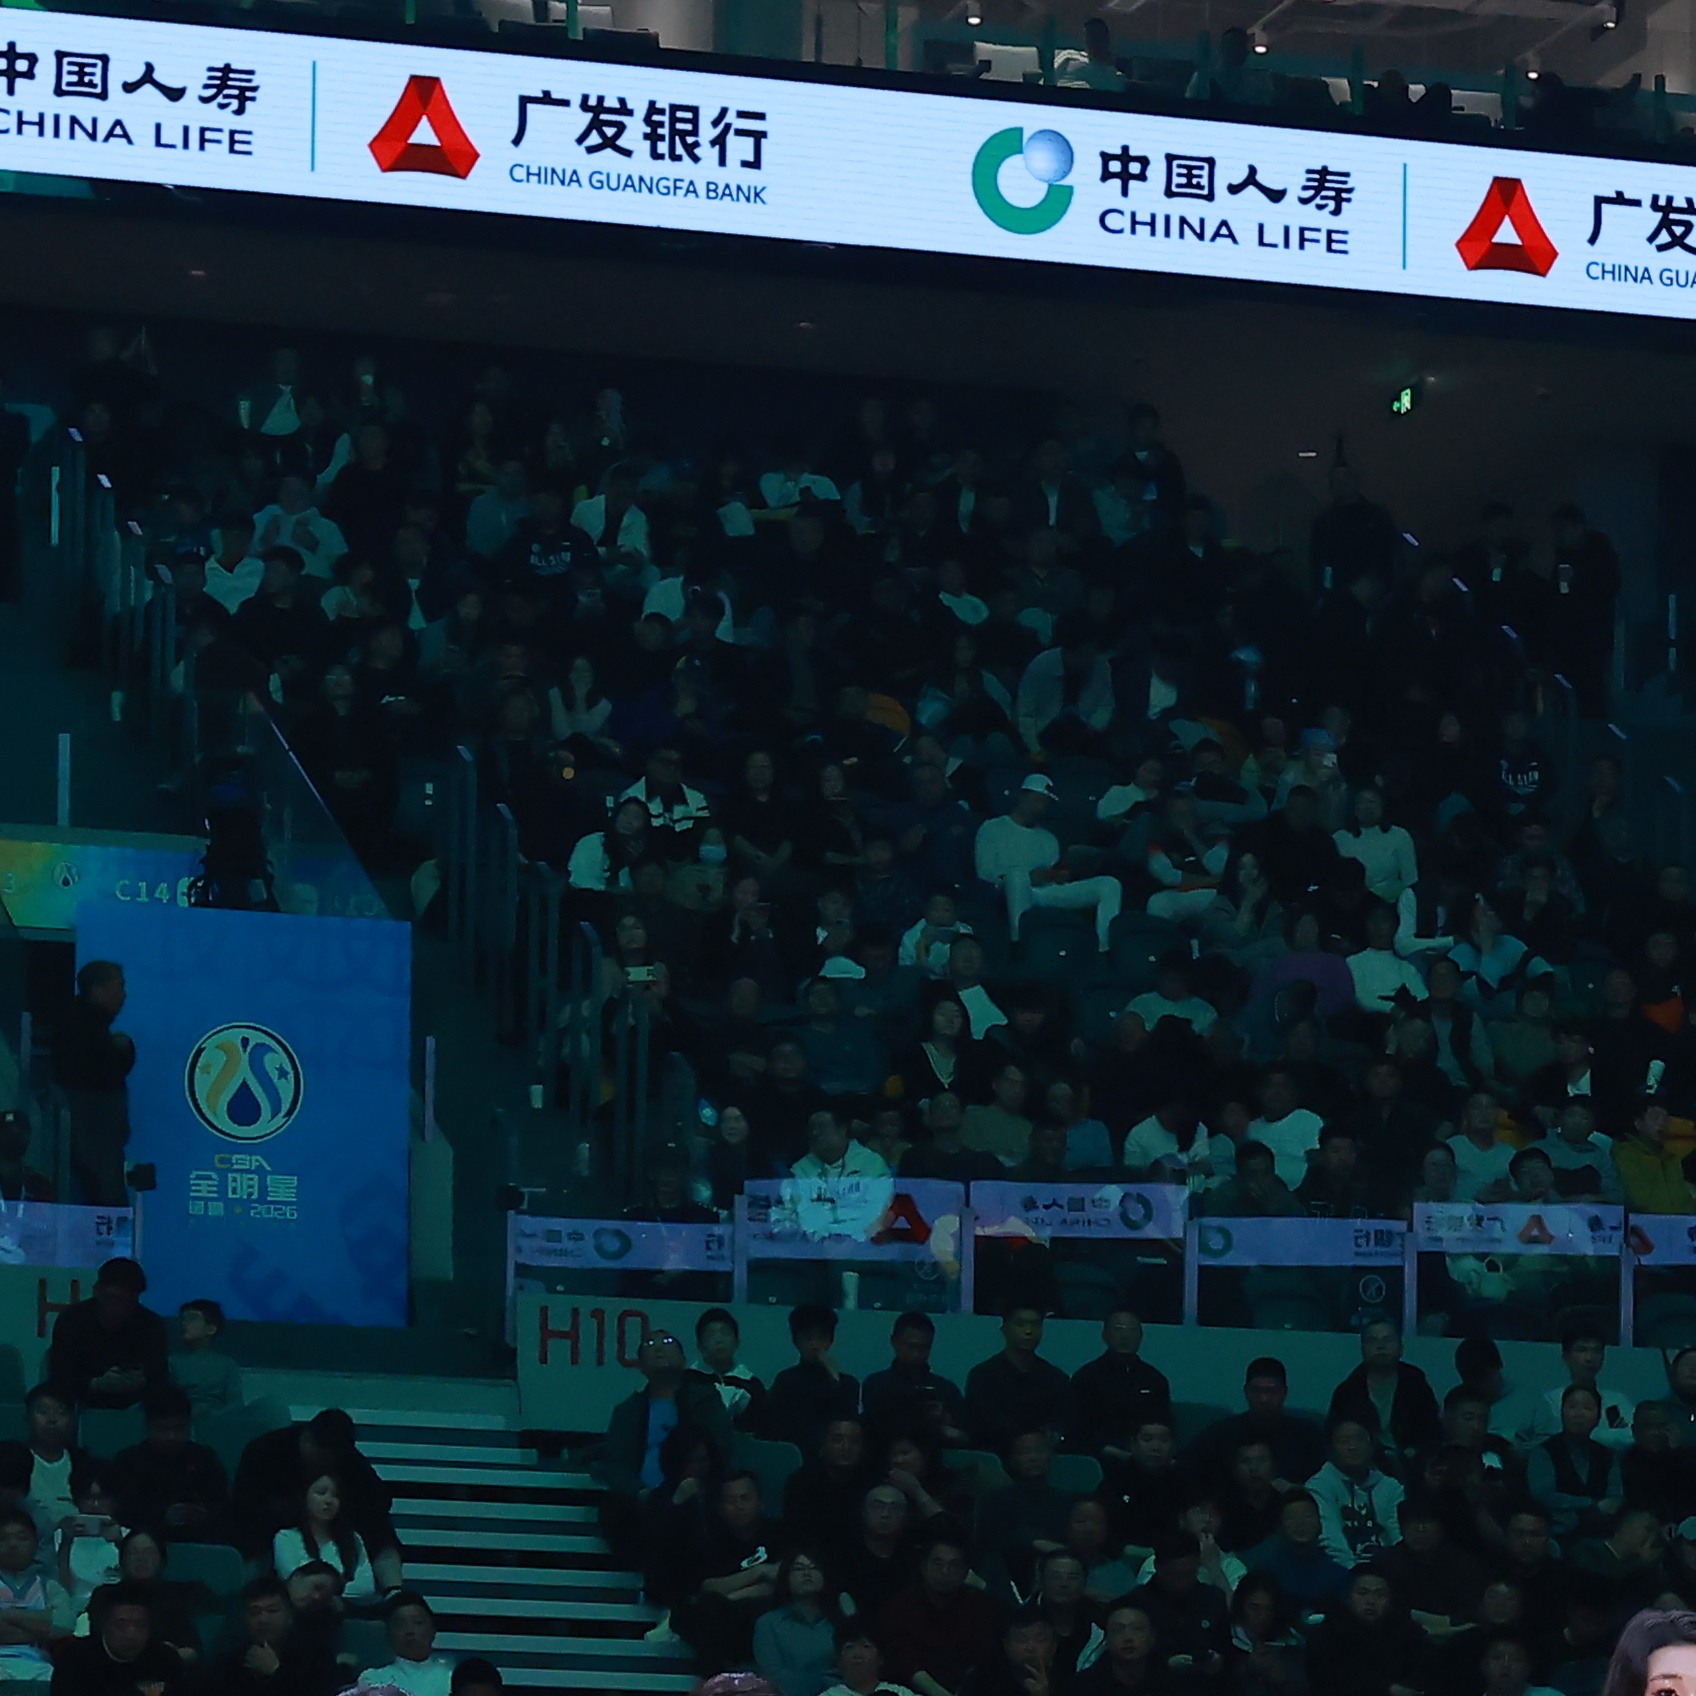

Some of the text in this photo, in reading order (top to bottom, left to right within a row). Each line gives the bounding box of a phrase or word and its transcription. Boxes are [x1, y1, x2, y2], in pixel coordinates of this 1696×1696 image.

[154, 121, 254, 157] LIFE
[510, 89, 769, 171] 广发银行
[508, 163, 767, 206] CHINA GUANGFA BANK
[1098, 143, 1356, 217] 中国人寿
[1098, 207, 1350, 256] CHINA LIFE
[1585, 260, 1654, 286] CHINA
[189, 1170, 298, 1202] 全明星
[537, 1305, 648, 1369] H10
